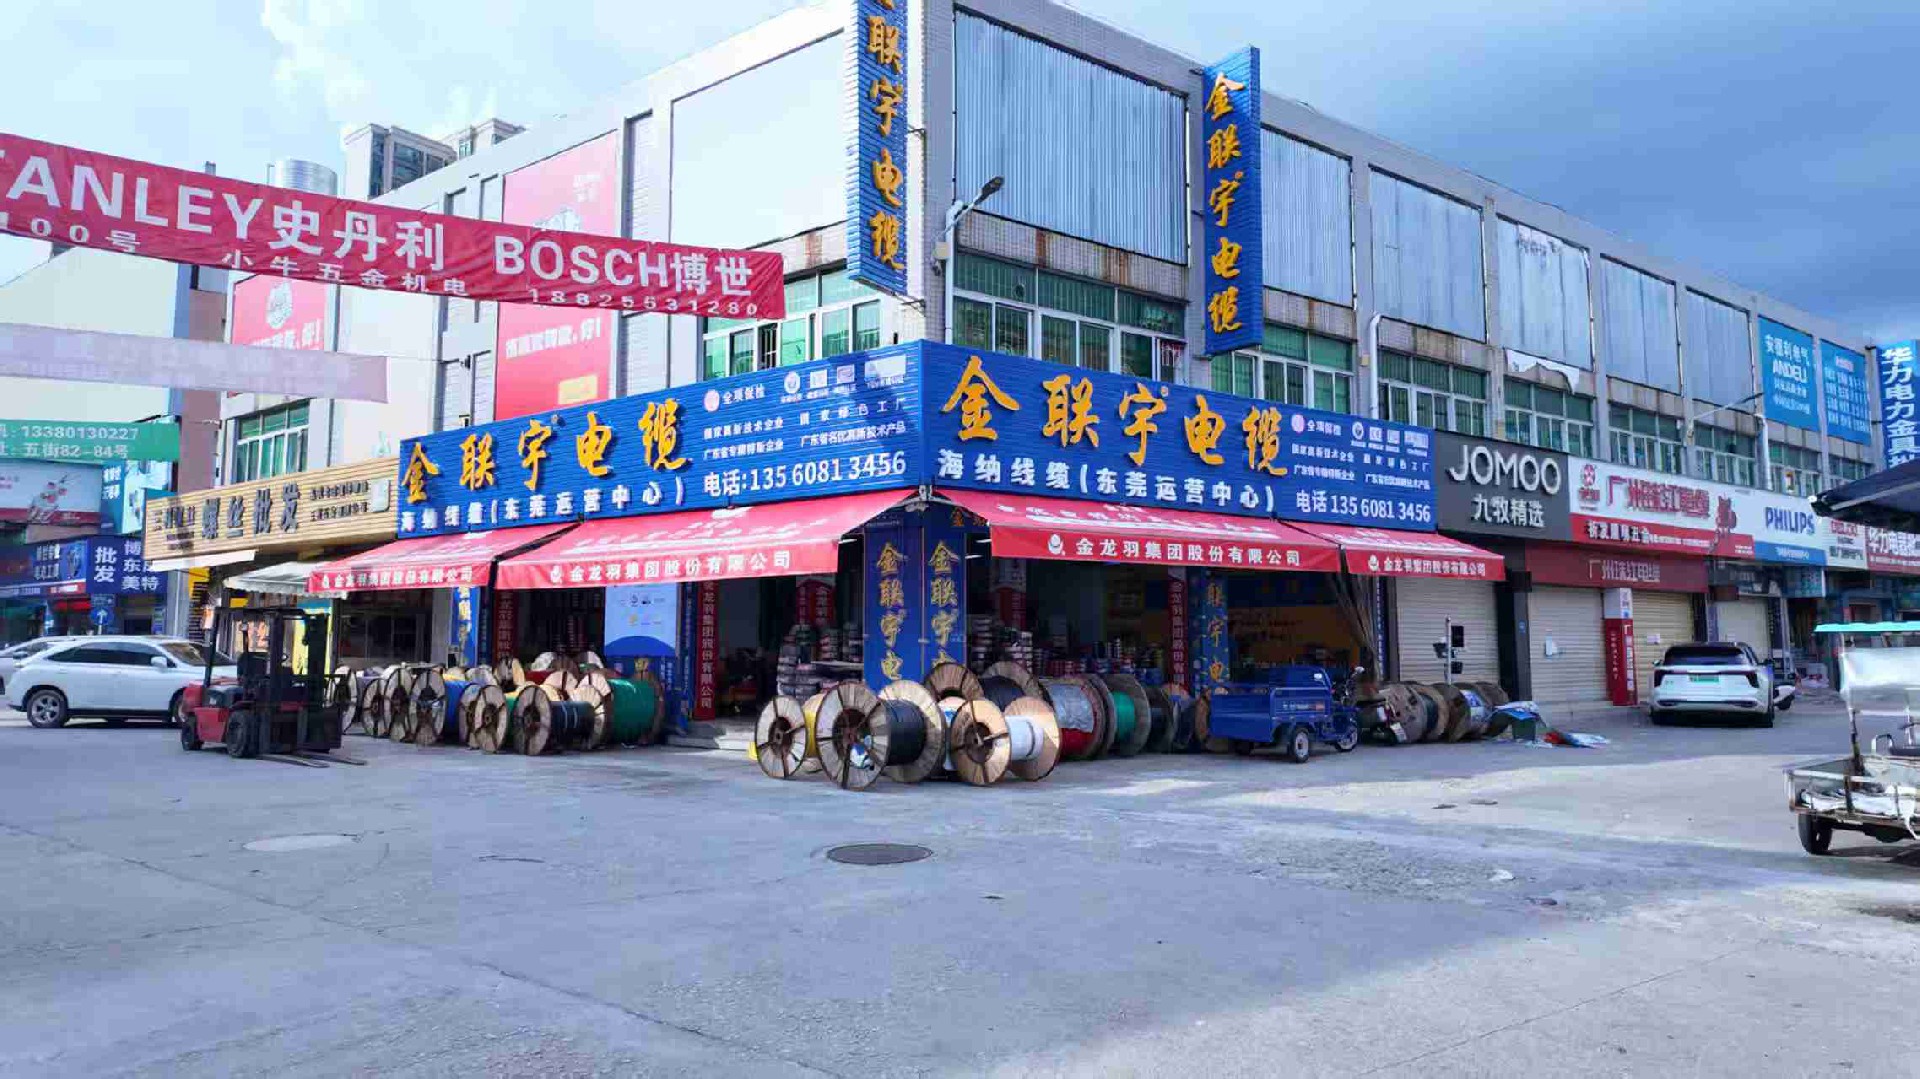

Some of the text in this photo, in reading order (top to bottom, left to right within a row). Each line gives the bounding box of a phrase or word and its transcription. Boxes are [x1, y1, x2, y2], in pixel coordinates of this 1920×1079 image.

[867, 0, 903, 270] 联宇电缆
[222, 249, 468, 296] 小牛五金机电
[941, 356, 1288, 476] 金联宇电缆
[402, 398, 692, 504] 金联宇电缆
[792, 458, 843, 486] 6081
[849, 451, 906, 479] 3456
[1450, 445, 1561, 495] JOMOO
[1331, 495, 1358, 515] 135
[1361, 499, 1395, 518] 6081
[1398, 502, 1431, 522] 3456
[1473, 494, 1546, 527] 九牧精选
[1765, 507, 1815, 535] PHILIPS
[569, 550, 791, 582] 金龙羽集团股份有限公司
[1075, 537, 1301, 567] 金龙羽集团股份有限公司
